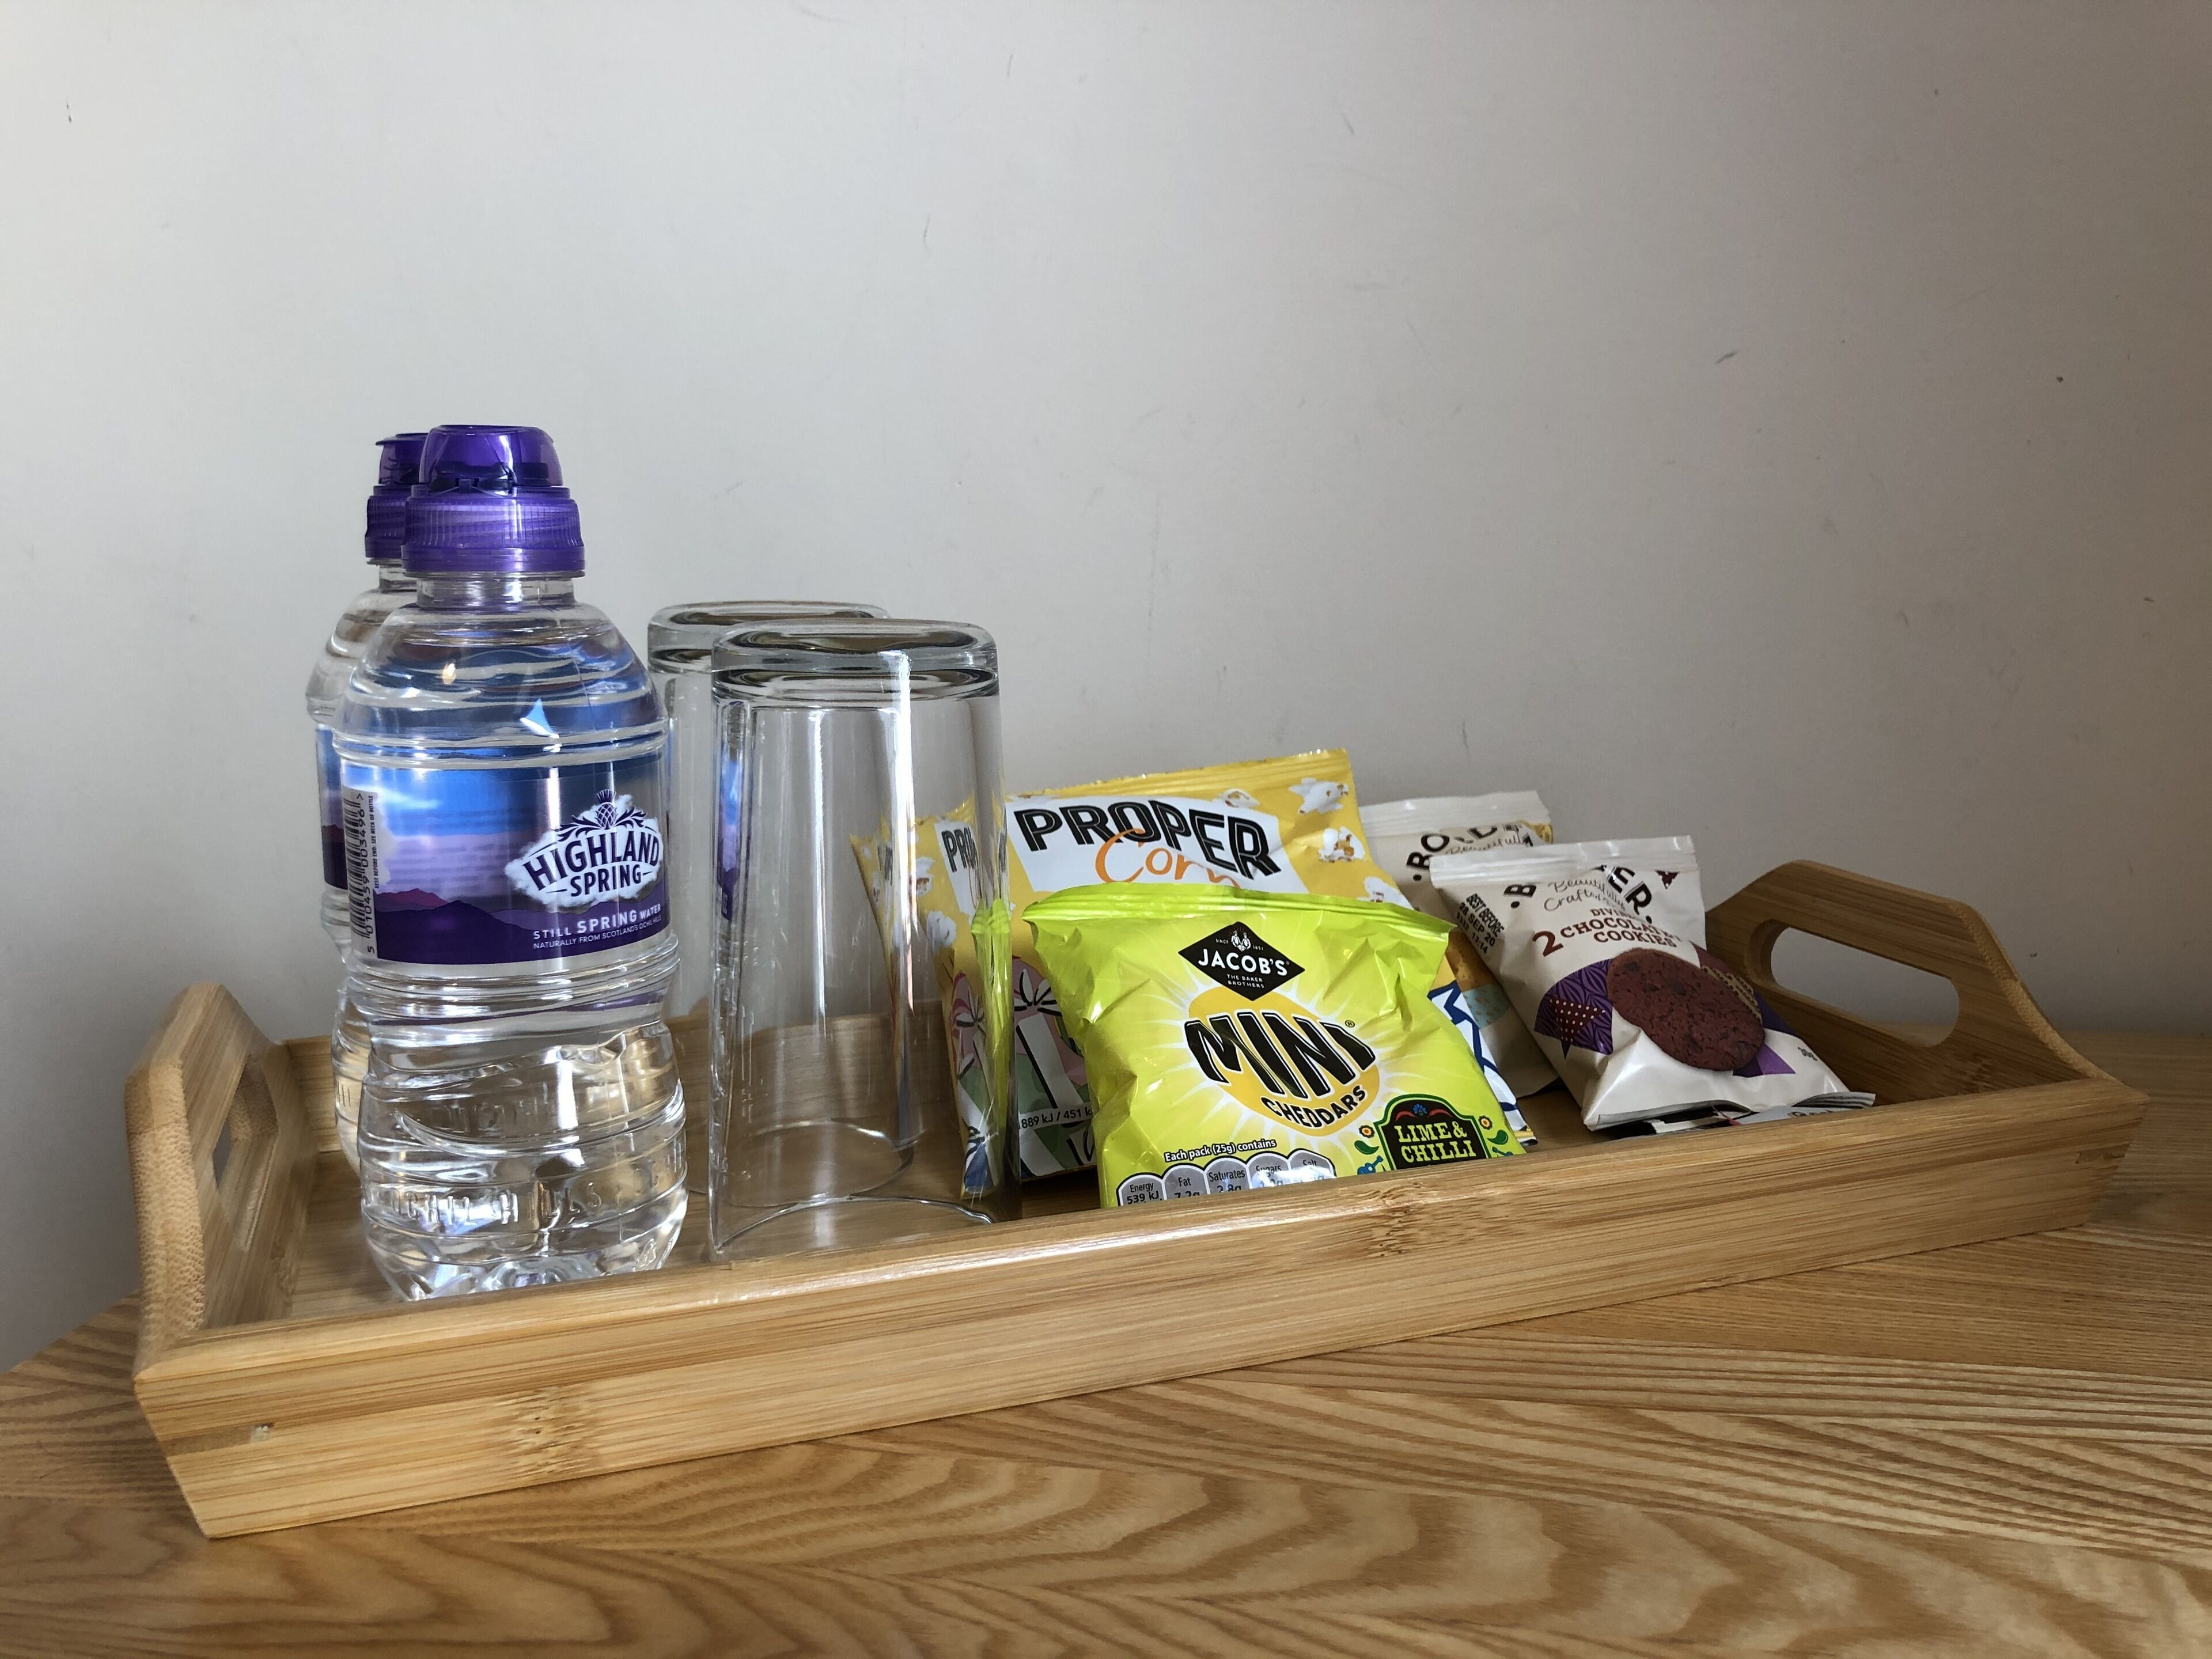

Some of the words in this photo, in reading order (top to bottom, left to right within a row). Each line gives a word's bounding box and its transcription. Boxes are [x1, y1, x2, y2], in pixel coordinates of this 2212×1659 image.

[358, 809, 369, 868] 003496
[1014, 800, 1281, 880] PROPER
[522, 831, 660, 891] HIGHLAND
[570, 864, 642, 897] SPRING
[362, 876, 373, 934] 010459
[1466, 893, 1487, 912] BEST
[1479, 907, 1505, 937] BEFORE
[533, 927, 572, 940] STILL
[577, 910, 638, 934] SPRING
[639, 903, 661, 919] WATER
[1459, 902, 1469, 916] 28
[1468, 914, 1485, 933] SEP
[1484, 932, 1496, 946] 20
[367, 945, 375, 954] 5
[533, 938, 577, 949] NATURALLY
[579, 934, 601, 944] FROM
[602, 925, 639, 939] SCOTLAND'S
[1532, 930, 1564, 957] 2
[1593, 930, 1677, 948] COOKIES
[1198, 948, 1287, 976] JACOB'S
[1228, 980, 1265, 988] BROTHERS
[1184, 1012, 1376, 1099] MINI
[1018, 1115, 1040, 1130] 889
[1041, 1113, 1054, 1123] kJ
[1056, 1111, 1061, 1122] /
[1063, 1108, 1082, 1119] 451
[1261, 1085, 1366, 1128] CHEDDARS
[1394, 1122, 1452, 1143] LIME
[1453, 1120, 1468, 1138] &
[1165, 1149, 1187, 1162] Each
[1188, 1146, 1211, 1160] pack
[1212, 1143, 1236, 1154] (25g)
[1237, 1138, 1277, 1151] contains
[1400, 1139, 1477, 1163] CHILLI
[1130, 1183, 1154, 1193] Energy
[1178, 1177, 1192, 1187] Fat
[1208, 1169, 1245, 1182] Saturates
[1127, 1193, 1146, 1205] 539
[1149, 1190, 1159, 1200] kJ
